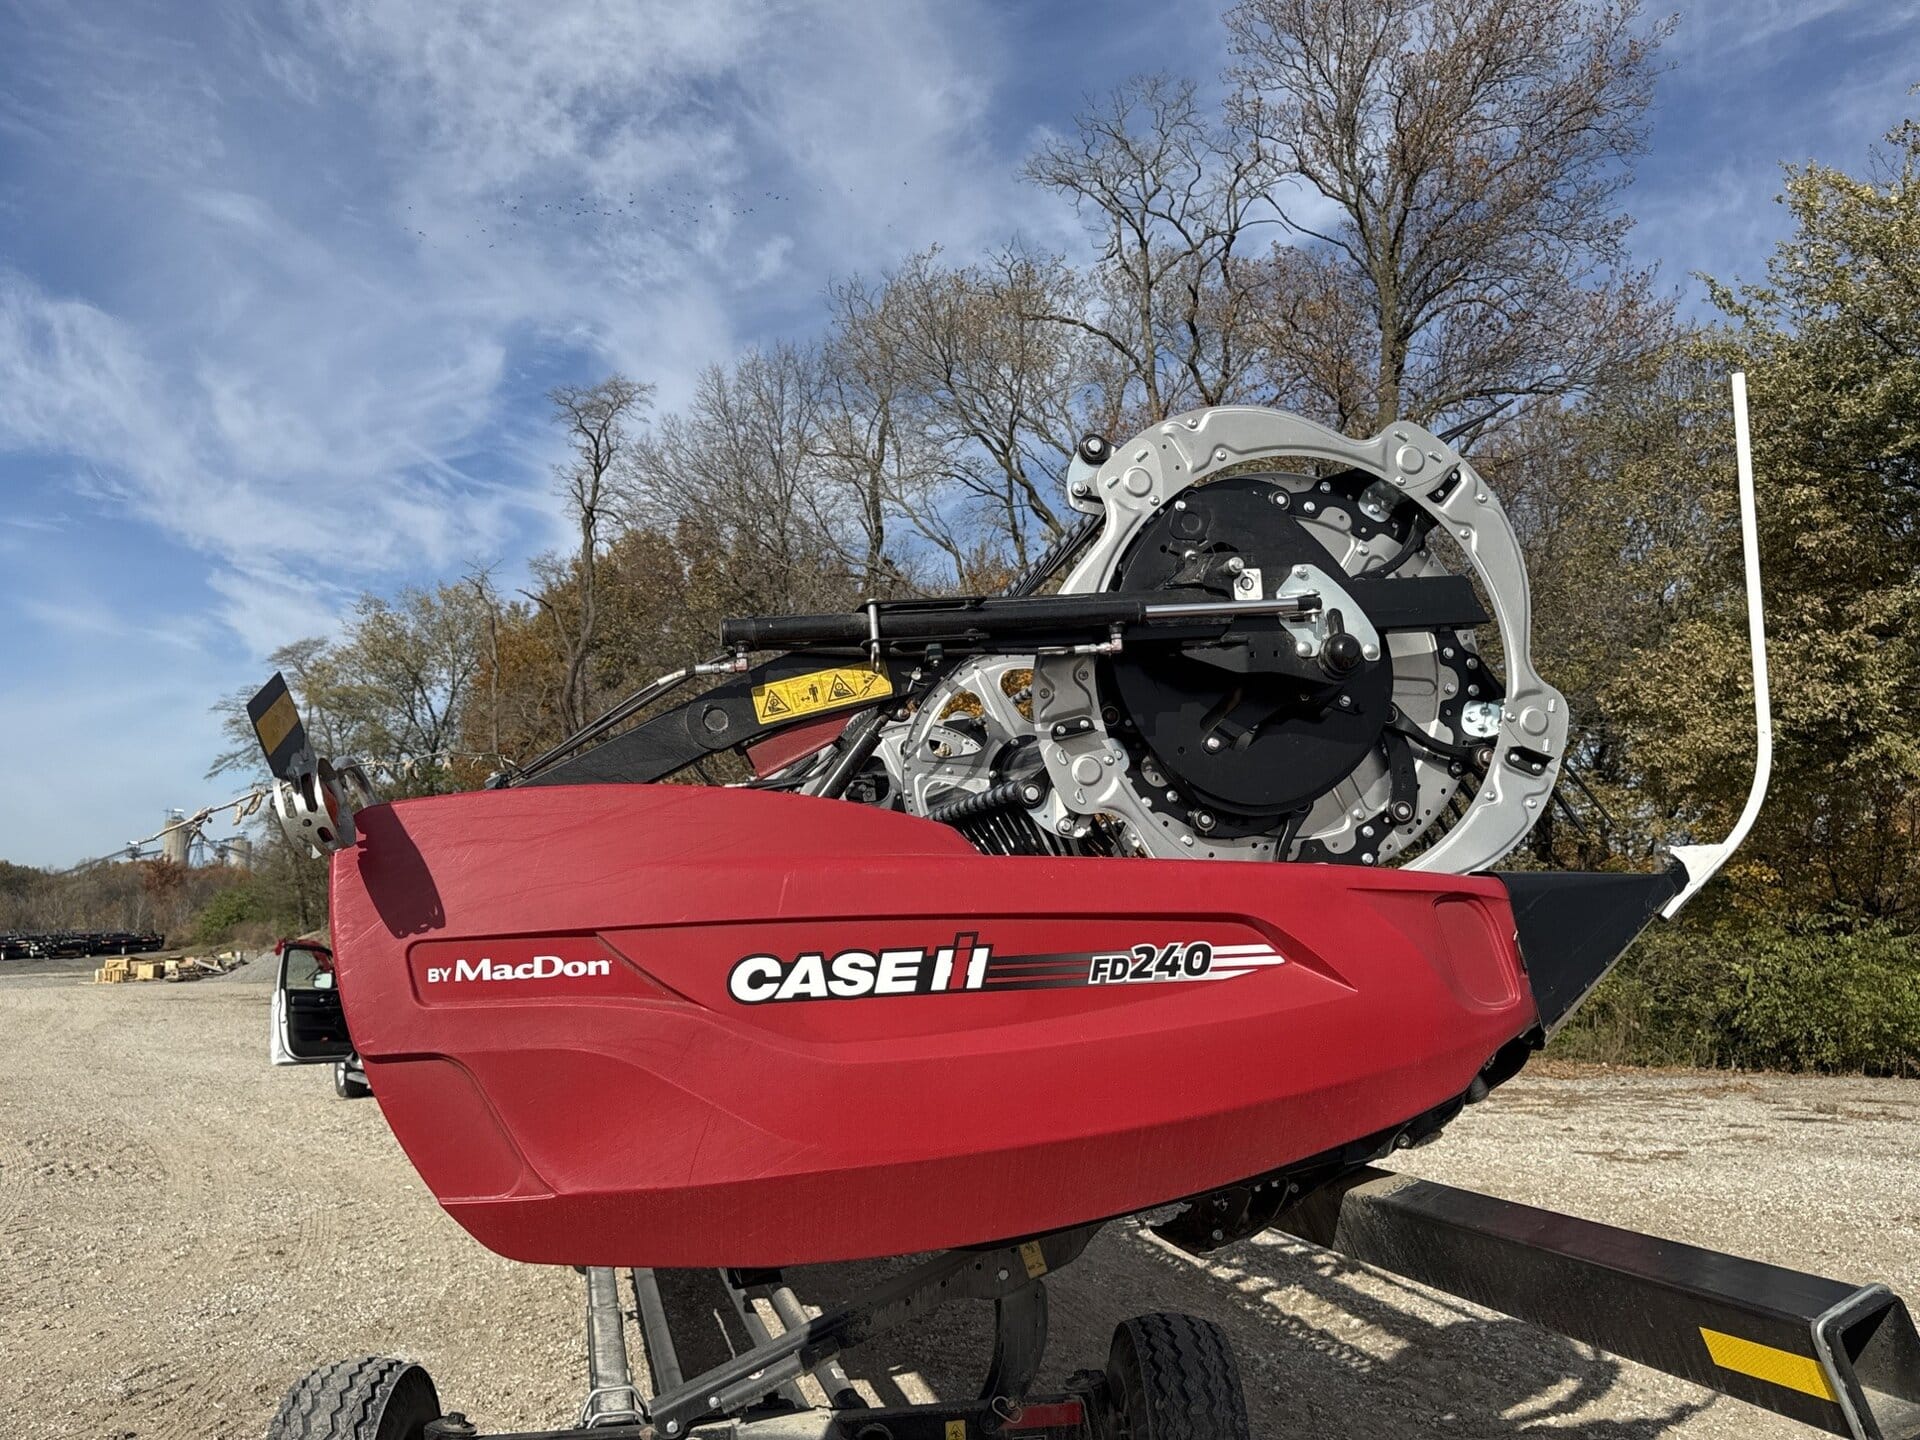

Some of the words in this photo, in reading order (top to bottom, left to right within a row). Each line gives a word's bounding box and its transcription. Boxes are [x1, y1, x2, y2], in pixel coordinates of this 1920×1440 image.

[427, 967, 452, 983] BY
[454, 955, 612, 982] MacDon
[729, 950, 924, 1002] CASE
[1088, 941, 1212, 984] FD240
